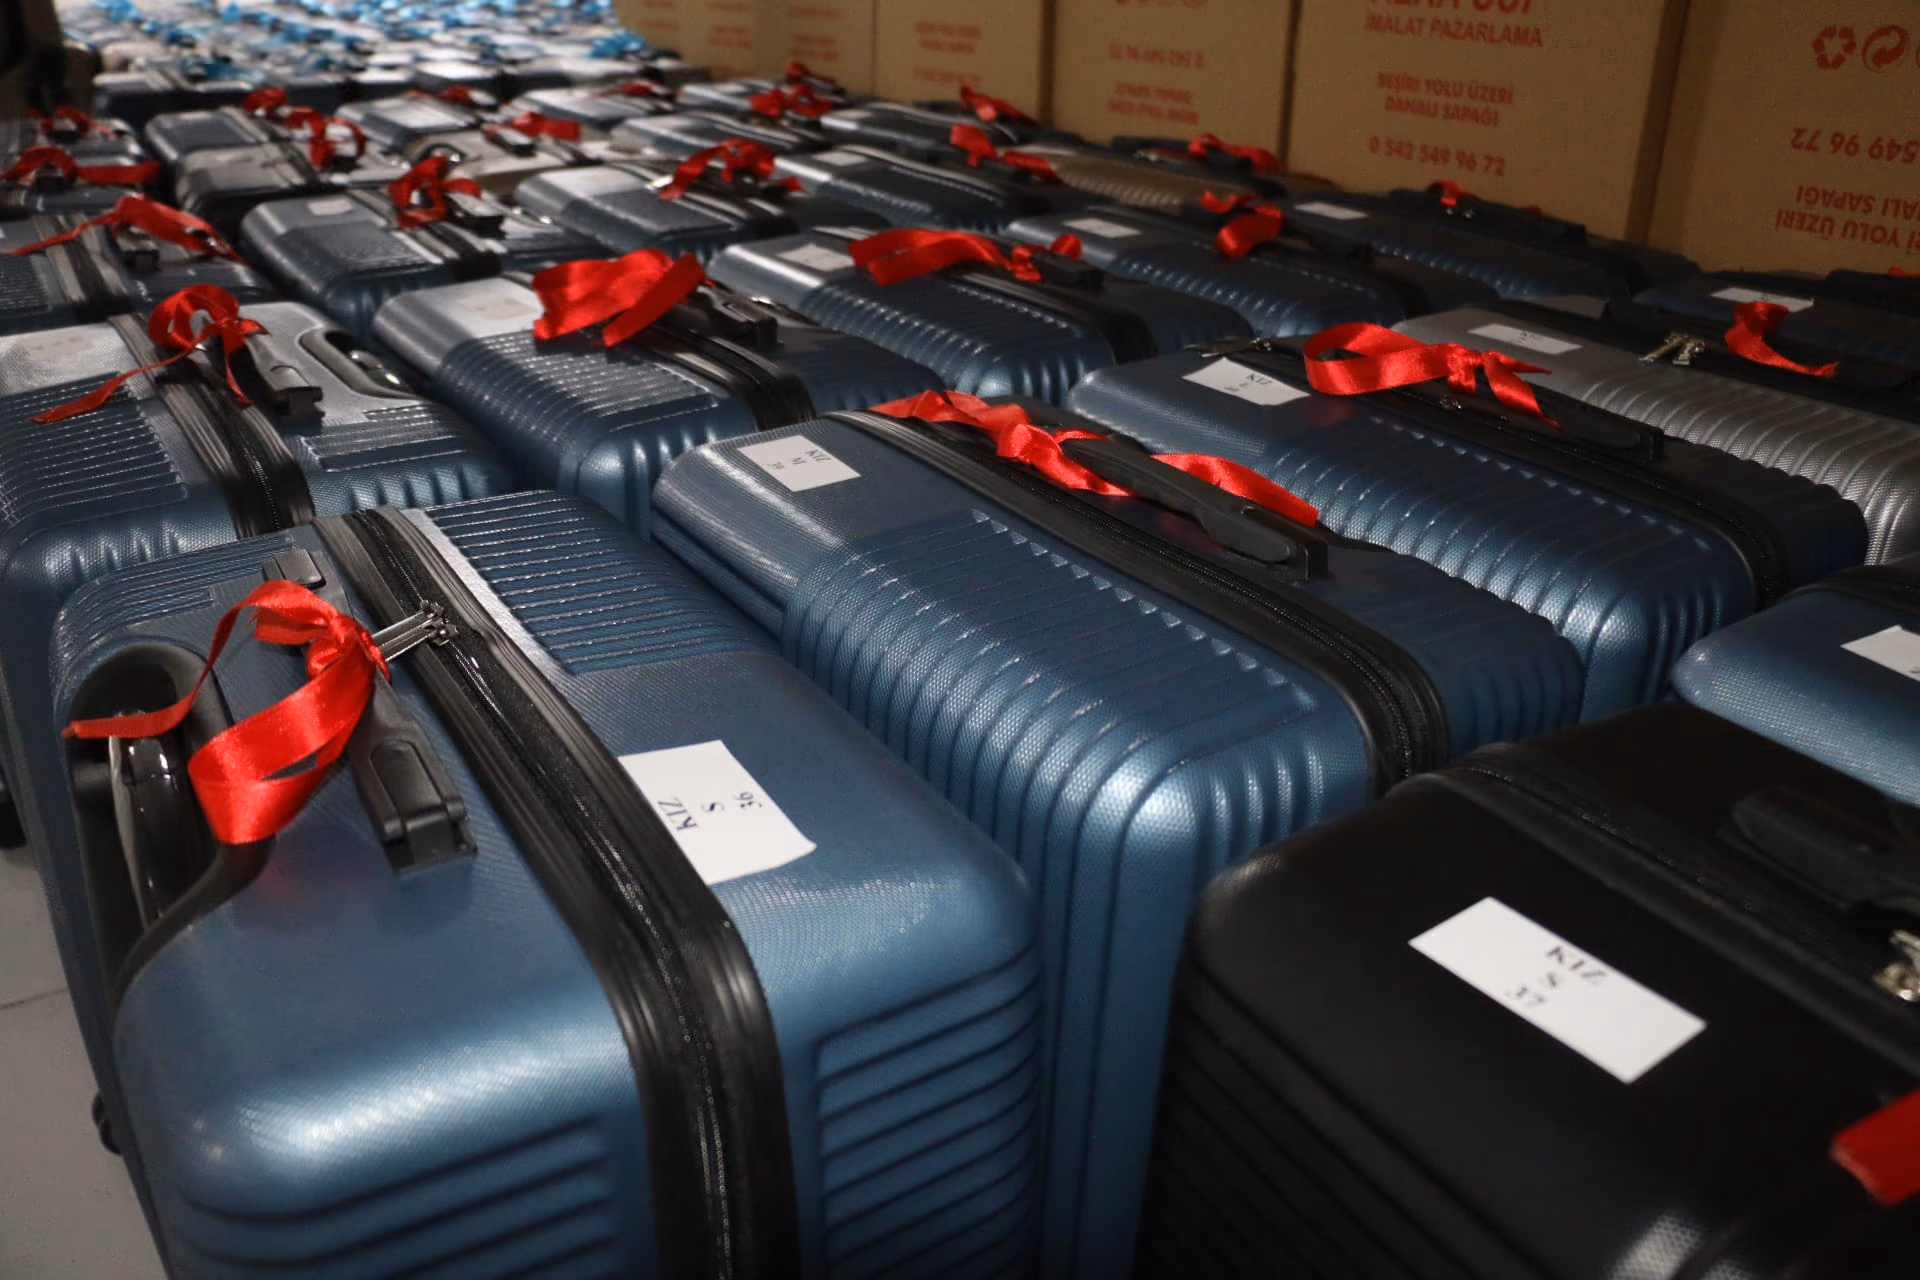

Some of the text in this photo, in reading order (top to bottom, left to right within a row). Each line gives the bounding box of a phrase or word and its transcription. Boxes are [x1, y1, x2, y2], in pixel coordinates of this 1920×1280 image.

[1430, 17, 1543, 48] PAZARLAMA
[1424, 78, 1464, 99] YOLU
[1369, 135, 1506, 177] 0 542 549 96 72
[1790, 127, 1920, 163] 549 96 72
[1775, 208, 1836, 240] ÜZERİ
[1841, 219, 1900, 249] YOLU
[656, 796, 701, 833] KIZ
[1547, 945, 1607, 985] KIZ
